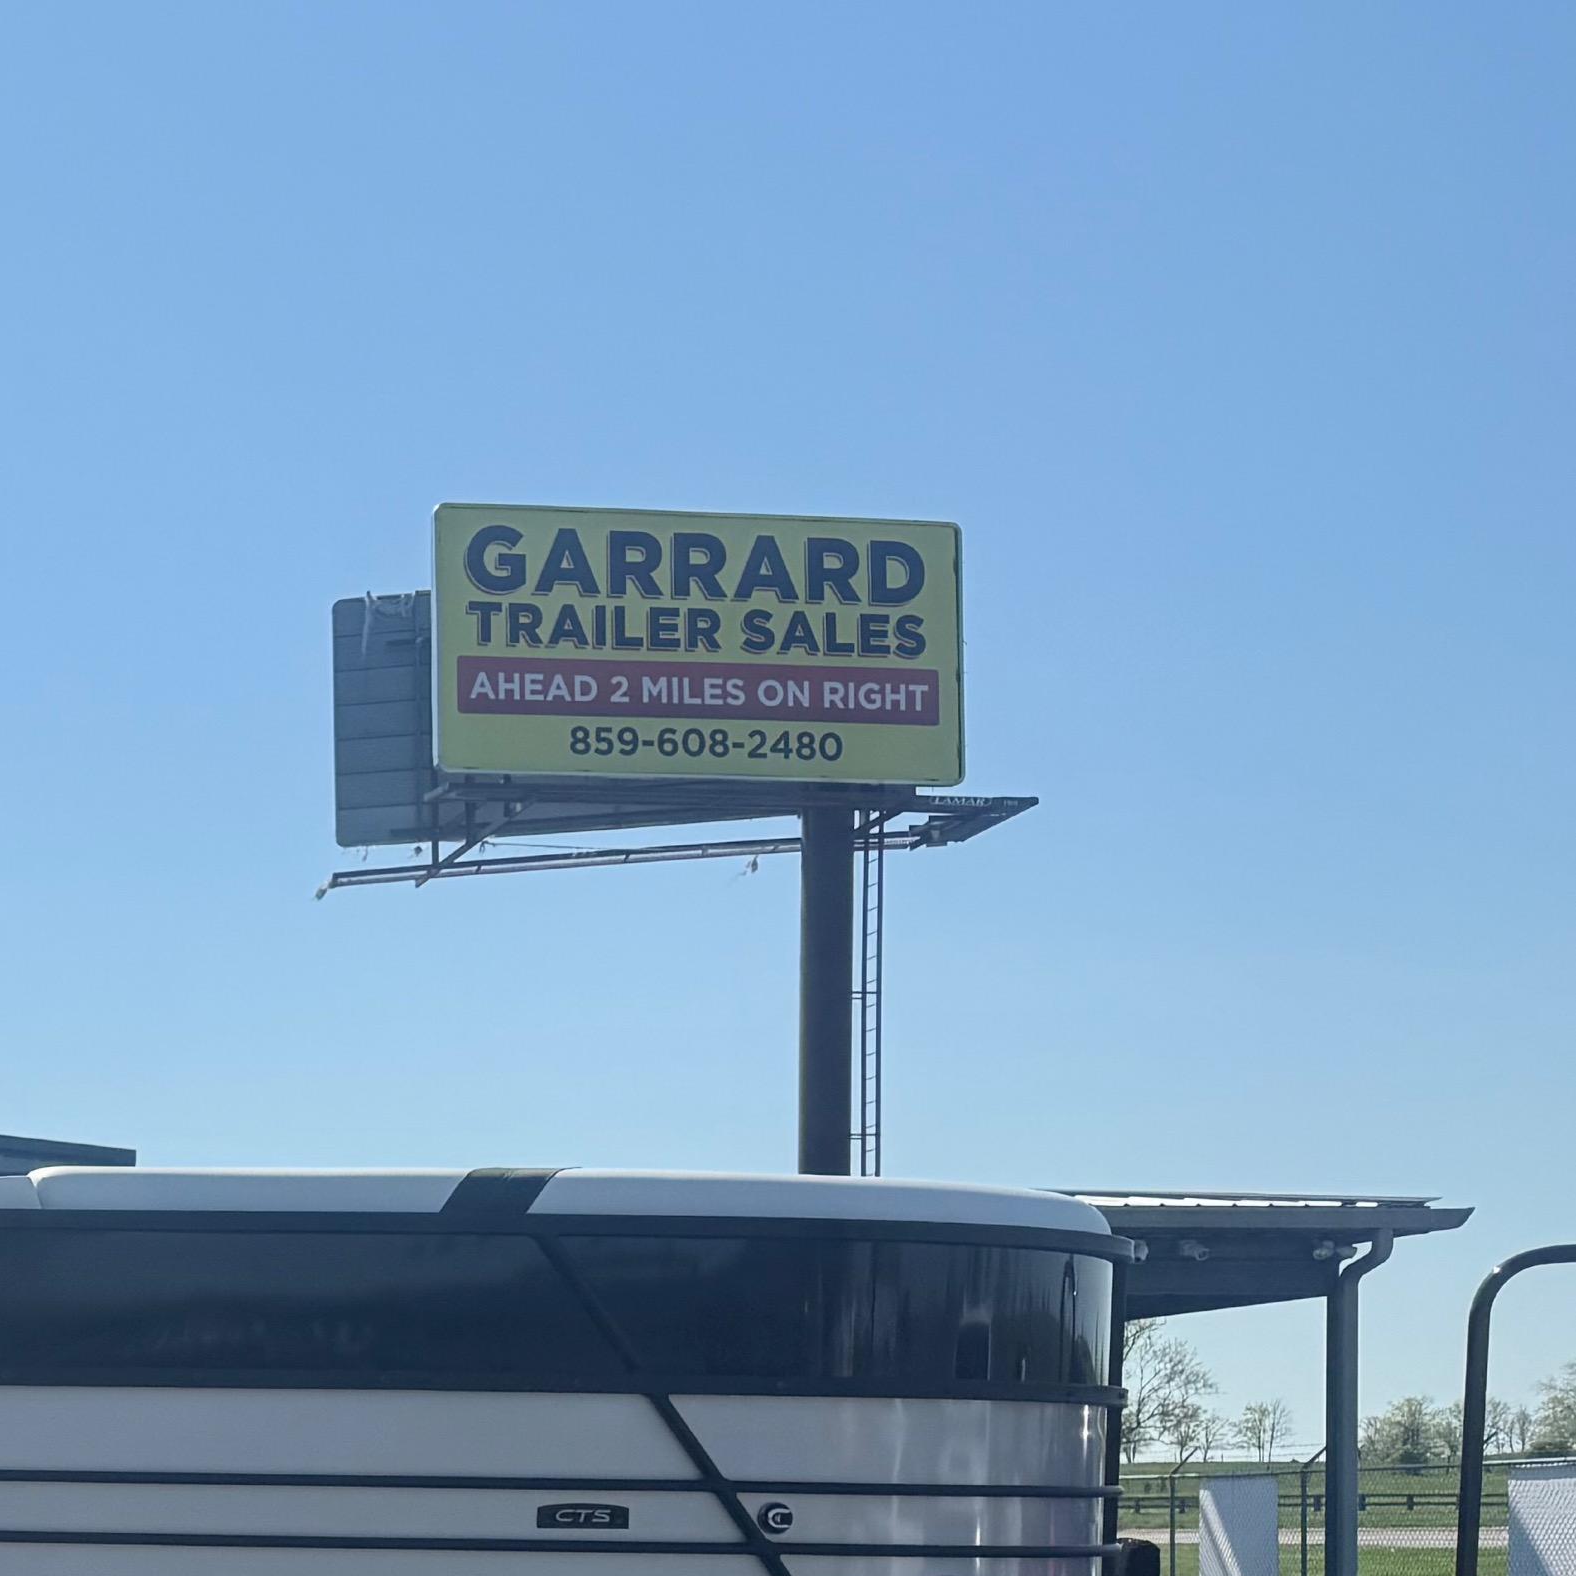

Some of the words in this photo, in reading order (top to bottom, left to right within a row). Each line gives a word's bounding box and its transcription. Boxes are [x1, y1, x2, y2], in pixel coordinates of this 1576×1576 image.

[464, 525, 926, 607] GARRARD
[466, 600, 722, 652] TRAILER
[740, 608, 927, 660] SALES
[470, 672, 598, 702] AHEAD
[610, 676, 630, 703] 2
[642, 676, 746, 706] MILES
[757, 679, 810, 708] ON
[823, 681, 929, 712] RIGHT
[569, 726, 844, 761] 859-608-2480
[555, 1508, 612, 1523] CTS
